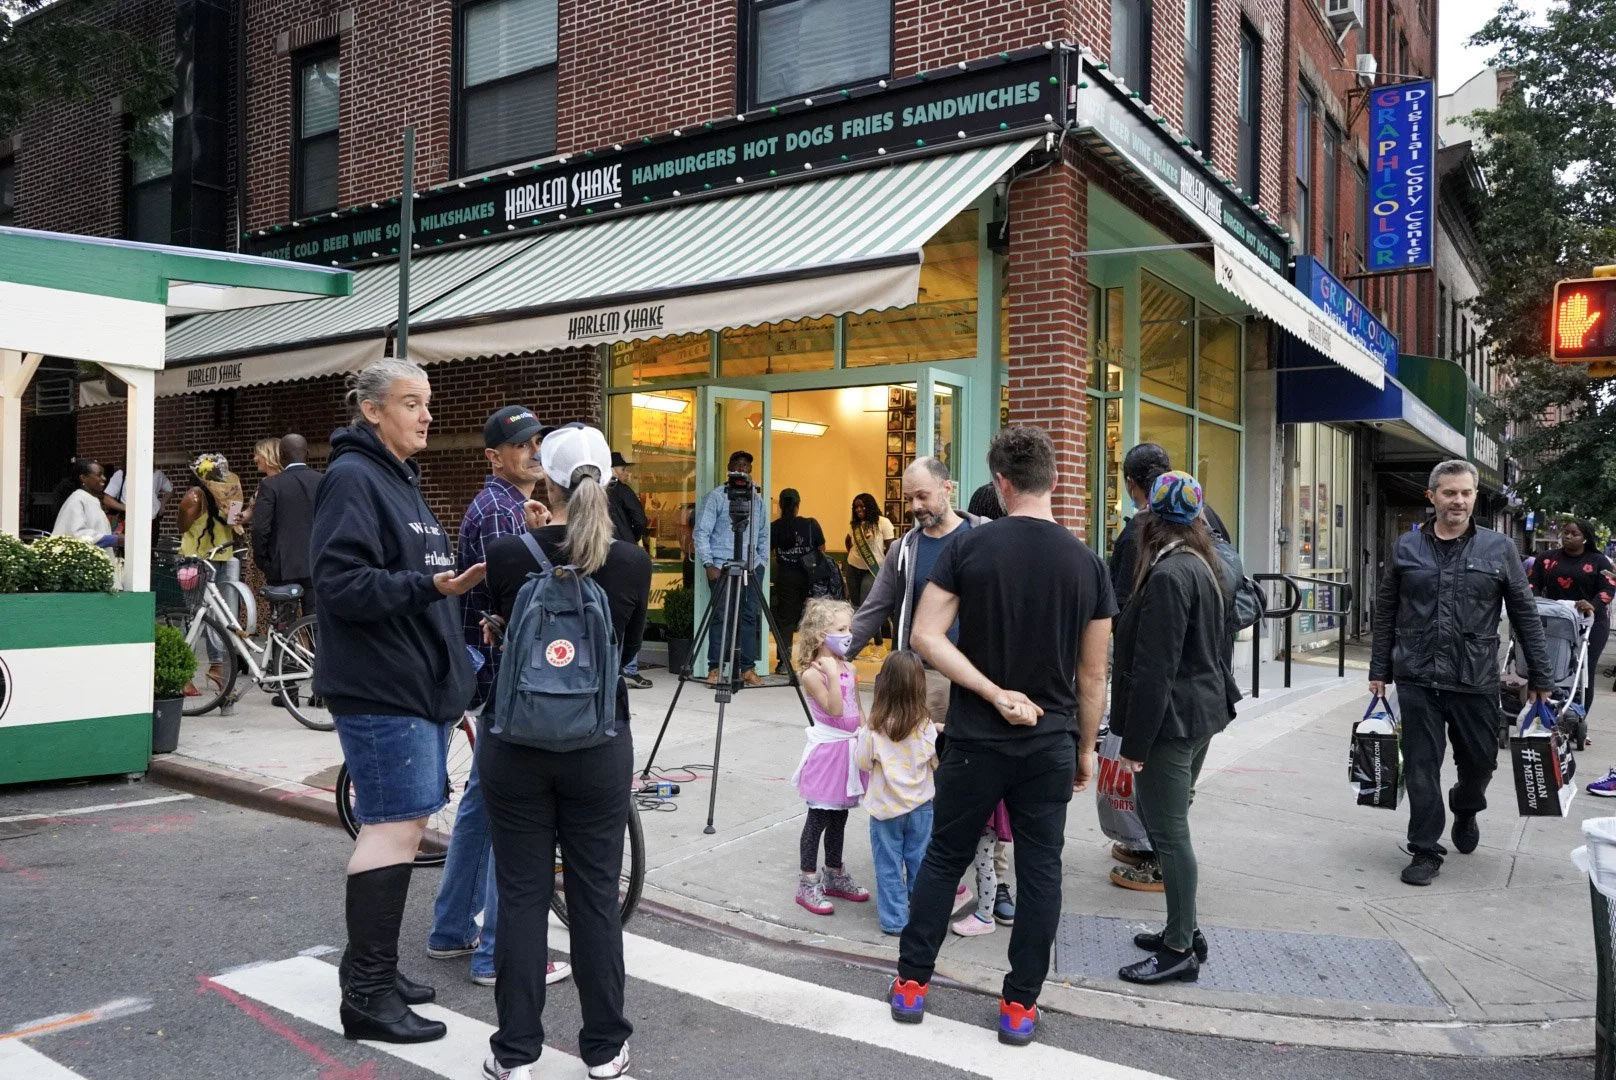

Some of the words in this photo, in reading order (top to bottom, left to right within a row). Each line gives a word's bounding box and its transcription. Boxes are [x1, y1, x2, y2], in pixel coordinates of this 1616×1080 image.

[1405, 89, 1426, 160] Digital
[294, 242, 319, 257] COLD
[323, 235, 349, 251] BEER
[353, 227, 382, 246] WINE
[386, 222, 416, 240] SOA
[420, 202, 495, 231] MILKSHAKES
[505, 176, 567, 220] HARLEM
[571, 163, 622, 207] SHAKE
[632, 146, 736, 185] HAMBURGERS
[743, 137, 778, 161] HOT
[785, 125, 834, 152] DOGS
[841, 112, 894, 139] FRIES
[902, 81, 1040, 127] SANDWICHES
[1373, 90, 1399, 265] GRAPHICOLOR
[1405, 165, 1425, 207] Copy
[1404, 210, 1425, 263] Center
[568, 312, 620, 340] HARLEM
[622, 305, 665, 334] SHAKE
[187, 366, 217, 387] HARLEM
[218, 363, 242, 384] SHAKE
[1523, 764, 1538, 809] MEADOW
